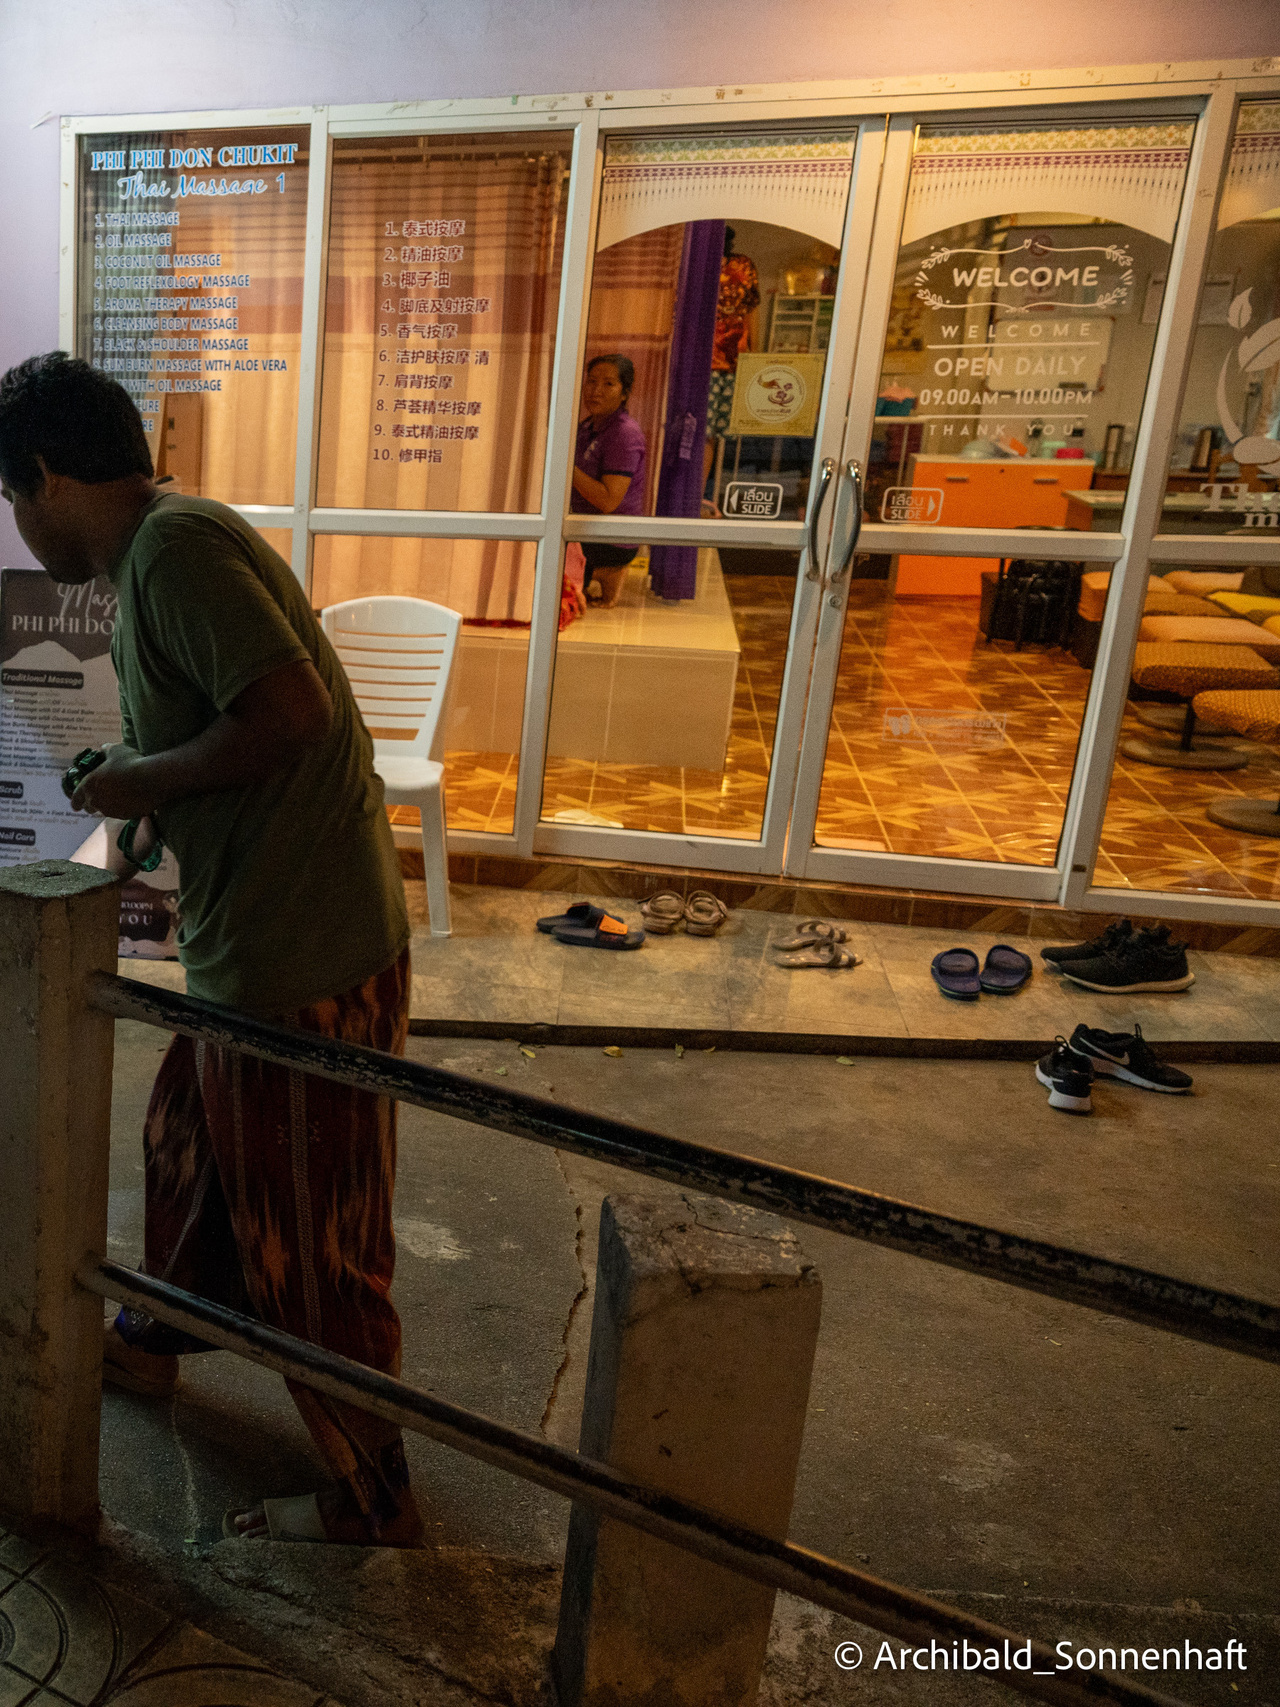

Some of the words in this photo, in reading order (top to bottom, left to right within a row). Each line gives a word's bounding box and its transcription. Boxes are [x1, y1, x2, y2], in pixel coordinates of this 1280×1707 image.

[91, 151, 126, 170] PHI
[130, 150, 165, 169] PHI
[169, 148, 213, 168] DON
[218, 144, 298, 165] CHUKIT
[117, 171, 171, 199] Thai
[171, 174, 268, 198] Massage
[276, 172, 285, 193] 1
[95, 214, 103, 227] 1.
[105, 213, 131, 226] THAI
[132, 212, 179, 226] MASSAGE
[385, 222, 399, 236] 1.
[95, 235, 103, 248] 2.
[106, 234, 123, 247] OIL
[124, 233, 172, 247] MASSAGE
[384, 248, 397, 261] 2.
[94, 255, 103, 269] 3.
[105, 255, 154, 268] COCONUT
[155, 254, 172, 267] OIL
[173, 254, 221, 267] MASSAGE
[94, 276, 103, 290] 4.
[106, 276, 133, 289] FOOT
[134, 275, 201, 289] REFLEXOLOGY
[202, 274, 250, 288] MASSAGE
[382, 274, 396, 287] 3.
[953, 266, 1100, 287] WELCOME
[104, 297, 142, 310] AROMA
[144, 297, 189, 310] THERAPY
[189, 296, 238, 310] MASSAGE
[381, 300, 395, 313] 4.
[94, 318, 103, 331] 6.
[104, 318, 160, 331] CLEANSING
[161, 317, 189, 331] BODY
[190, 317, 239, 330] MASSAGE
[380, 324, 392, 337] 5.
[941, 324, 1091, 339] WELCOME
[103, 338, 136, 352] BLACK
[136, 338, 146, 352] &
[147, 338, 200, 352] SHOULDER
[201, 338, 249, 351] MASSAGE
[379, 351, 391, 362] 6.
[103, 359, 124, 372] SUN
[126, 359, 154, 372] BURN
[156, 359, 203, 372] MASSAGE
[204, 359, 232, 372] WITH
[234, 359, 259, 372] ALOE
[261, 358, 288, 371] VERA
[935, 357, 1004, 377] OPEN
[1015, 356, 1086, 376] DAILY
[157, 380, 174, 392] OIL
[175, 379, 222, 392] MASSAGE
[377, 375, 389, 387] 7.
[376, 399, 388, 412] 8.
[374, 425, 386, 436] 9.
[929, 424, 1006, 436] THANK
[1027, 424, 1074, 436] YOU
[373, 449, 394, 461] 10.
[742, 503, 772, 515] SLIDE
[891, 509, 921, 519] SLIDE
[12, 615, 43, 631] PHI
[49, 616, 80, 634] PHI
[2, 673, 47, 683] Traditional
[48, 675, 83, 685] Massage
[0, 786, 23, 795] Scrub
